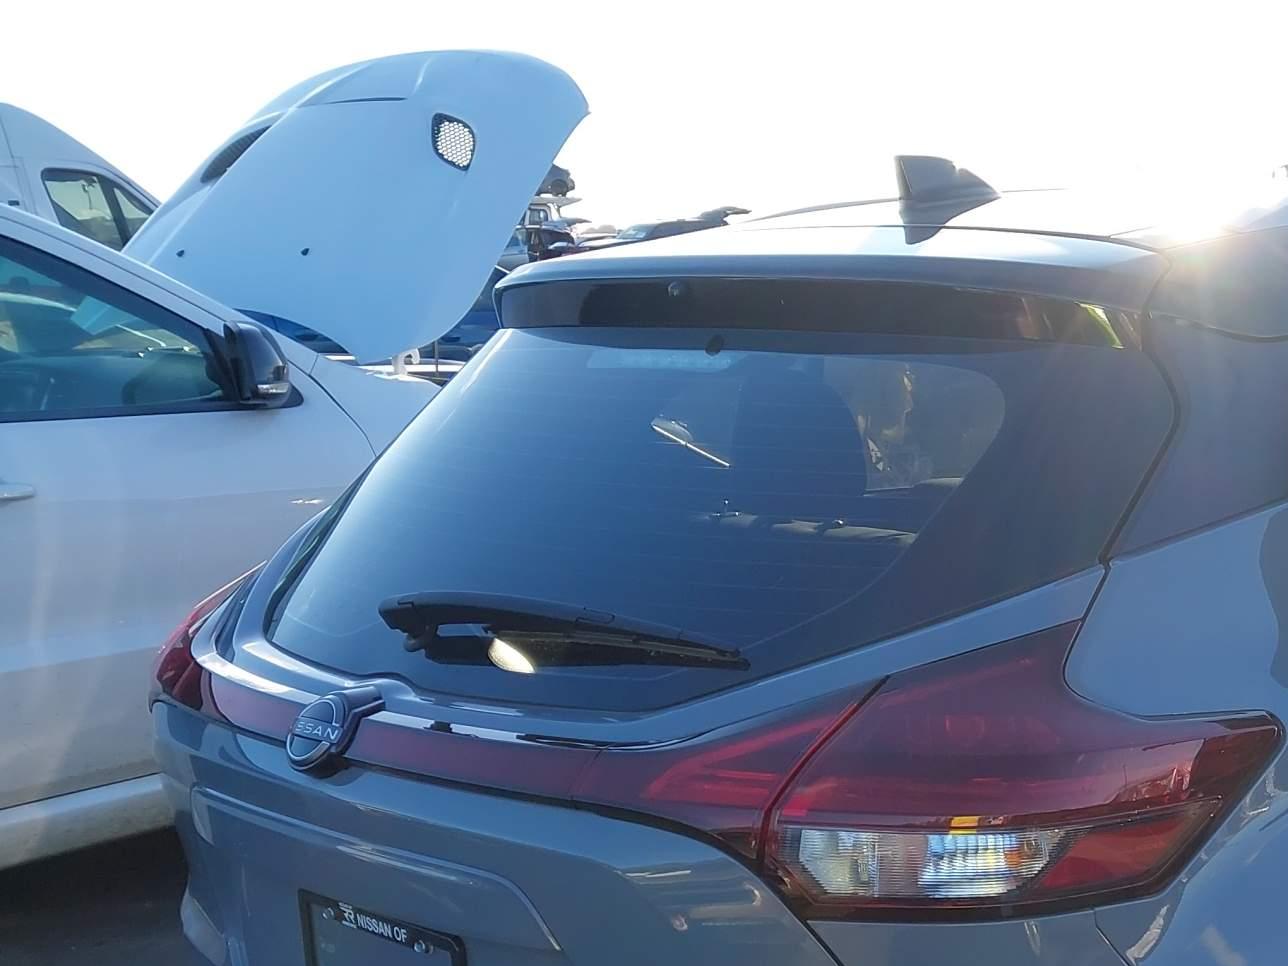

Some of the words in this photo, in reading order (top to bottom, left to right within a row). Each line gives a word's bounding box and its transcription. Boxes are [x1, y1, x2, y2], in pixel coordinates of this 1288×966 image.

[293, 719, 339, 740] SSAN
[357, 913, 393, 939] NISSAN
[393, 928, 408, 942] OF
